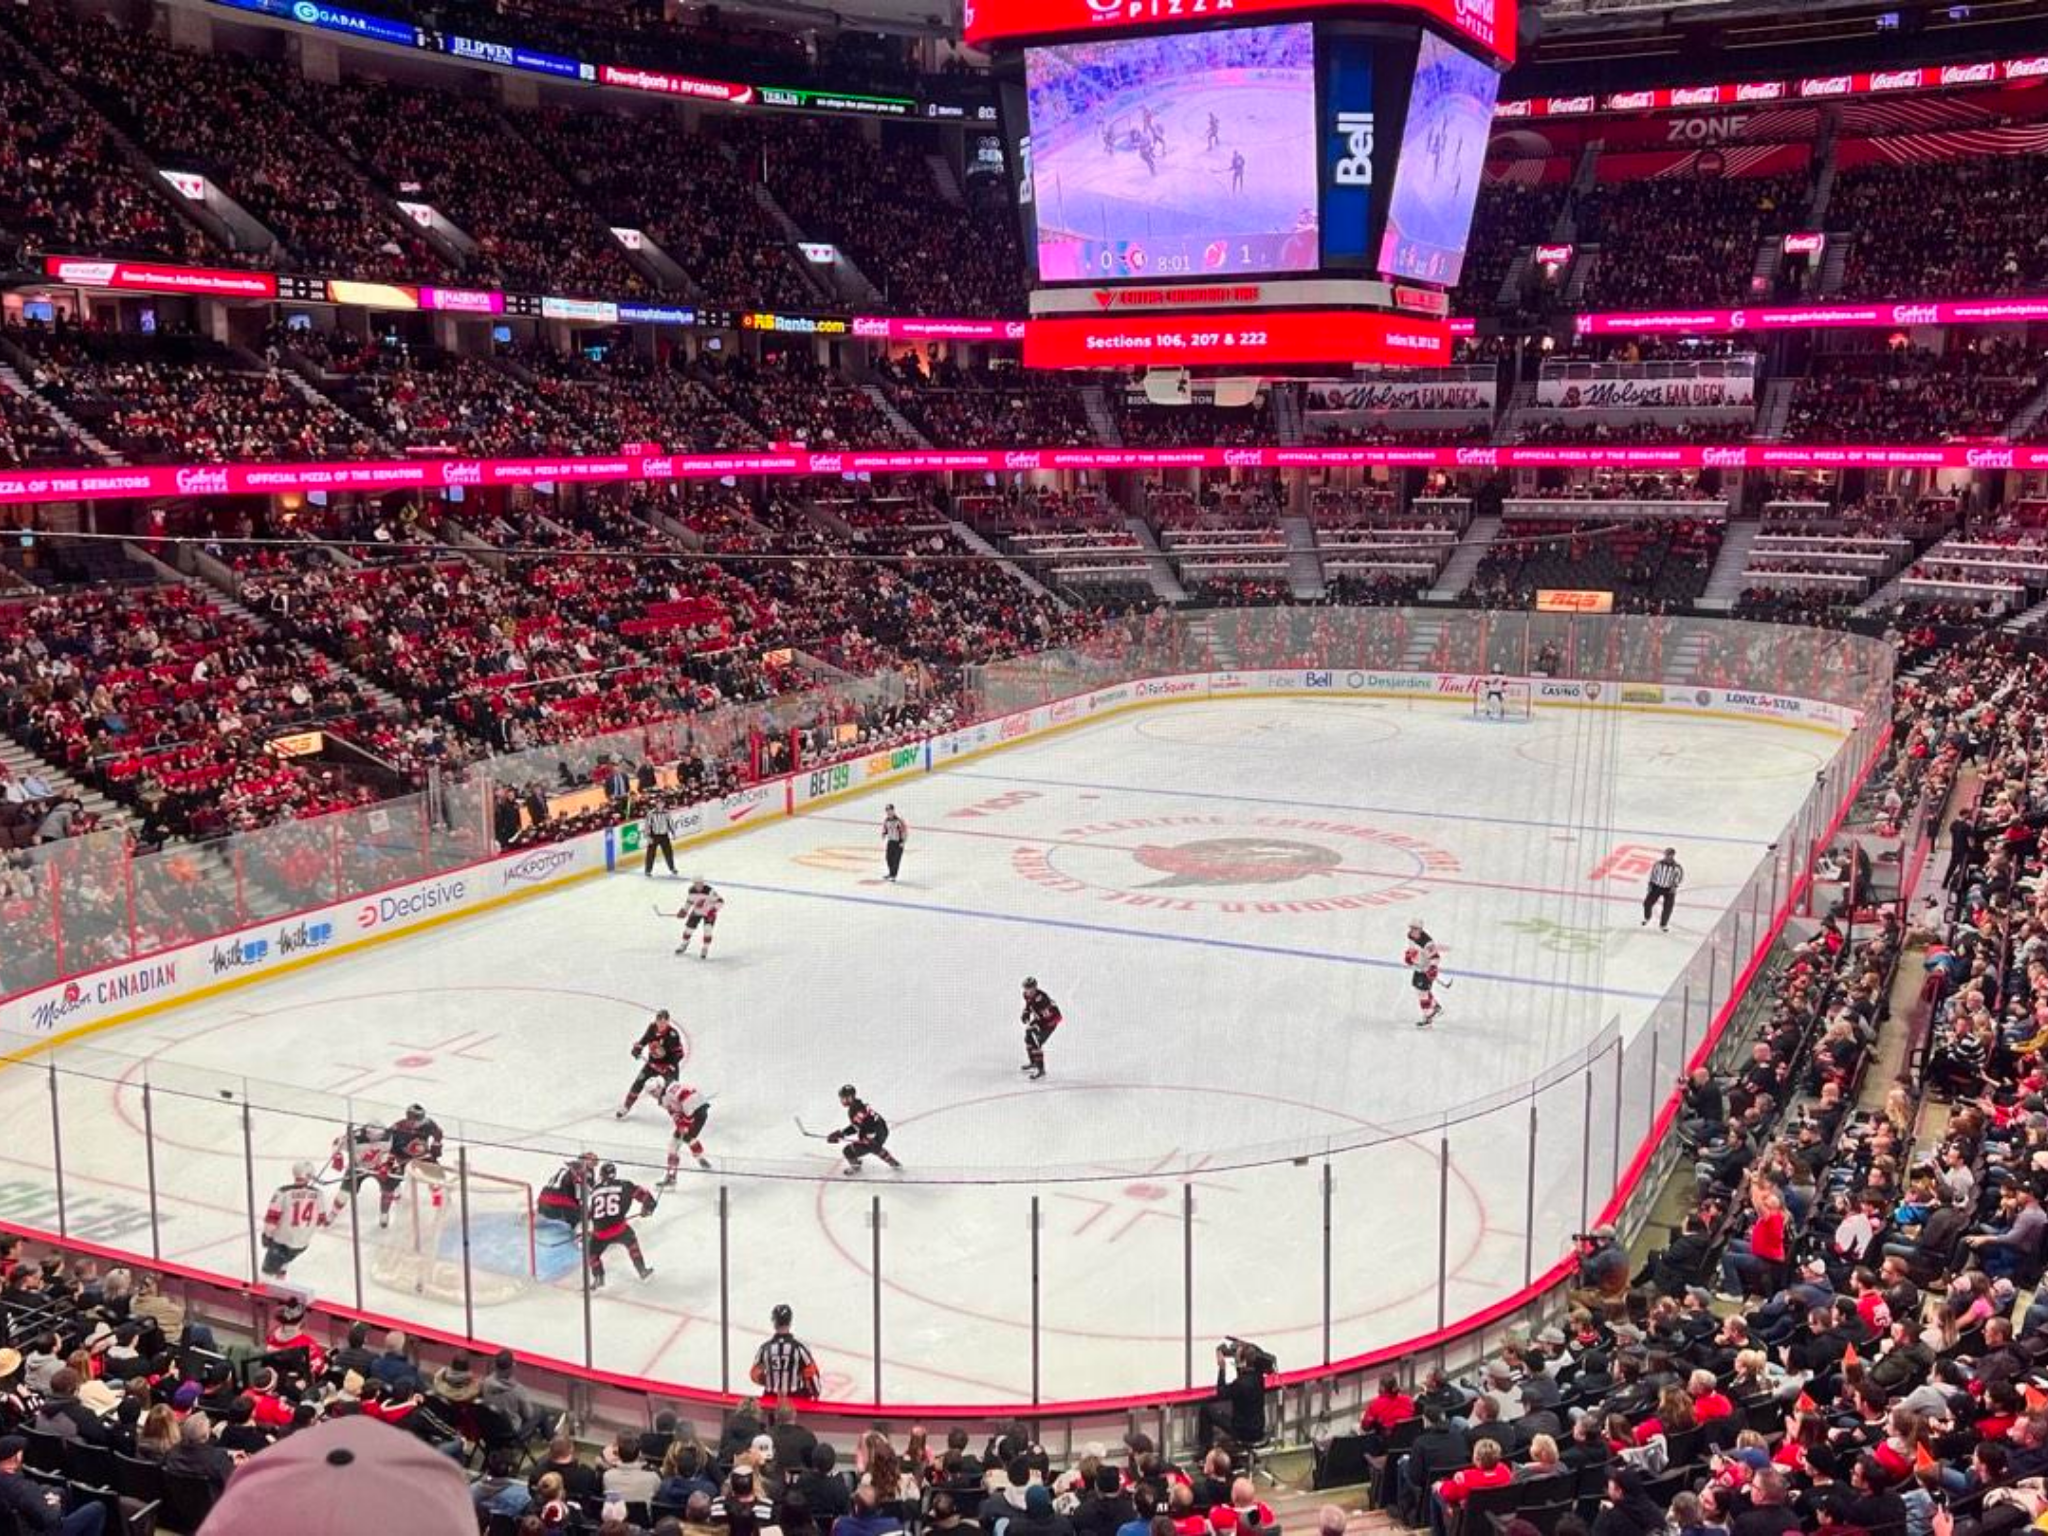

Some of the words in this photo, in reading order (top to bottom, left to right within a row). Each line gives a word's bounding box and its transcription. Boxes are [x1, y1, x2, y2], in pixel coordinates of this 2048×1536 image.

[606, 66, 669, 89] PowerSports
[1337, 112, 1374, 185] Bell
[1101, 250, 1113, 270] 0
[1158, 254, 1191, 272] 8:01
[1241, 245, 1251, 263] 1
[1607, 315, 1715, 327] www.gabrielpizza.com
[1731, 310, 1745, 328] G
[1763, 310, 1877, 322] www.gabrielpizza.com
[1087, 334, 1151, 349] Sections
[1156, 334, 1186, 349] 106,
[1190, 333, 1219, 346] 207
[1223, 333, 1235, 346] &
[1240, 331, 1267, 346] 222
[1344, 385, 1420, 407] Molson
[1422, 388, 1445, 404] FAN
[1447, 387, 1478, 404] DECK
[1583, 381, 1661, 405] Molson
[1666, 384, 1691, 402] FAN
[1694, 383, 1727, 401] DECK
[176, 468, 228, 487] Gabriel
[247, 472, 298, 484] OFFICIAL
[300, 471, 333, 482] PIZZA
[334, 471, 349, 482] OF
[351, 470, 371, 480] THE
[373, 468, 423, 480] SENATORS
[442, 462, 481, 478] Gabriel
[28, 480, 48, 491] OF
[51, 479, 79, 491] THE
[81, 476, 150, 490] SENATORS
[1306, 671, 1332, 688] Bell
[1368, 675, 1431, 690] Desjardins
[1437, 676, 1461, 692] Tim
[1541, 686, 1580, 697] CASINO
[1725, 693, 1756, 706] LONE
[1773, 698, 1800, 711] STAR
[868, 745, 919, 777] SUBWAY
[809, 764, 849, 797] BET99
[504, 849, 575, 887] JACKPOTCITY
[381, 880, 464, 922] Decisive
[32, 991, 92, 1029] Molson
[98, 963, 176, 1004] CANADIAN
[290, 1200, 314, 1227] 14
[594, 1194, 620, 1219] 26
[771, 1355, 790, 1371] 37
